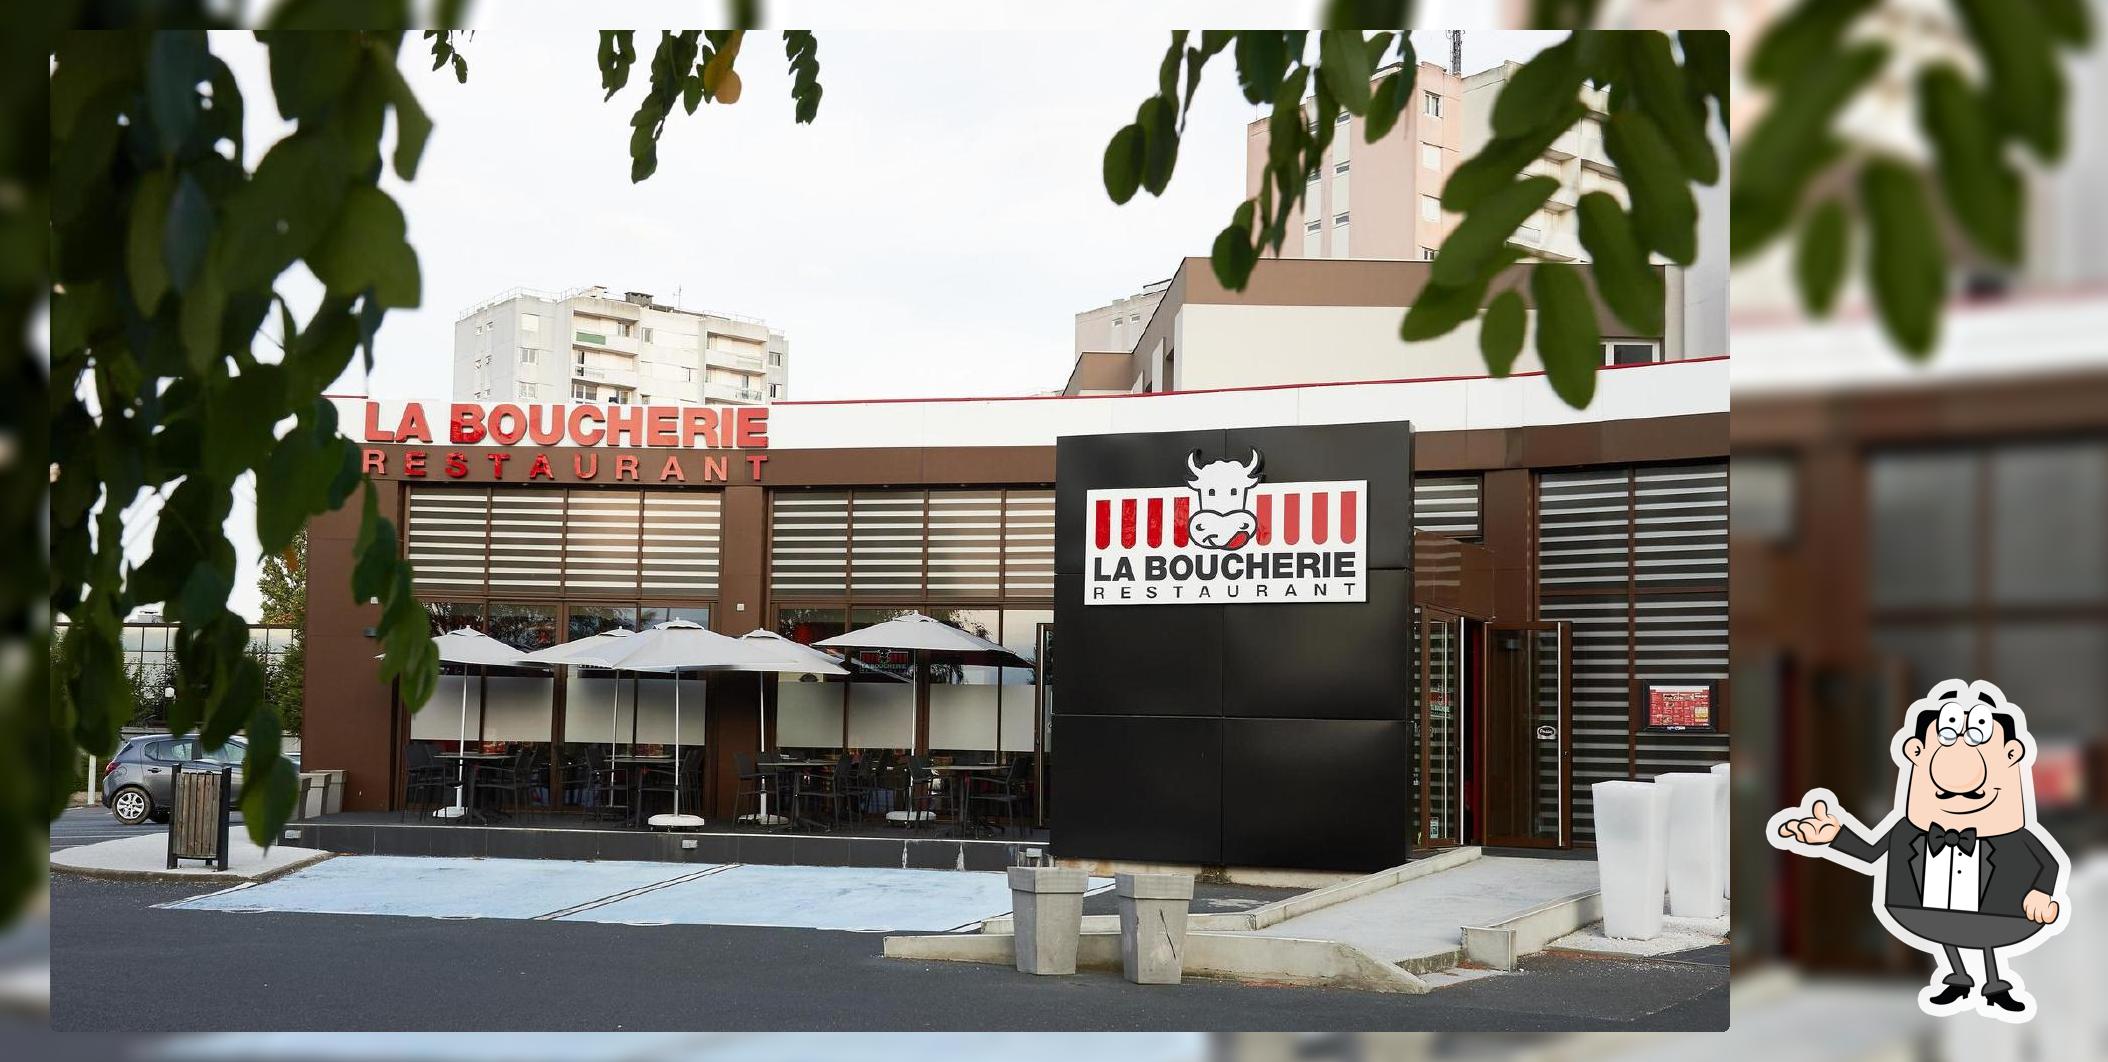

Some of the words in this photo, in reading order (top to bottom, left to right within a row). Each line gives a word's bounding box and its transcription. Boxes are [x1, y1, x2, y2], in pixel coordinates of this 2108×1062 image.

[364, 401, 433, 443] LA
[449, 402, 770, 449] BOUCHERIE
[362, 448, 769, 482] RESTAURANT
[1094, 556, 1136, 582] LA
[1145, 551, 1356, 581] BOUCHERIE
[1093, 582, 1356, 600] RESTAURANT
